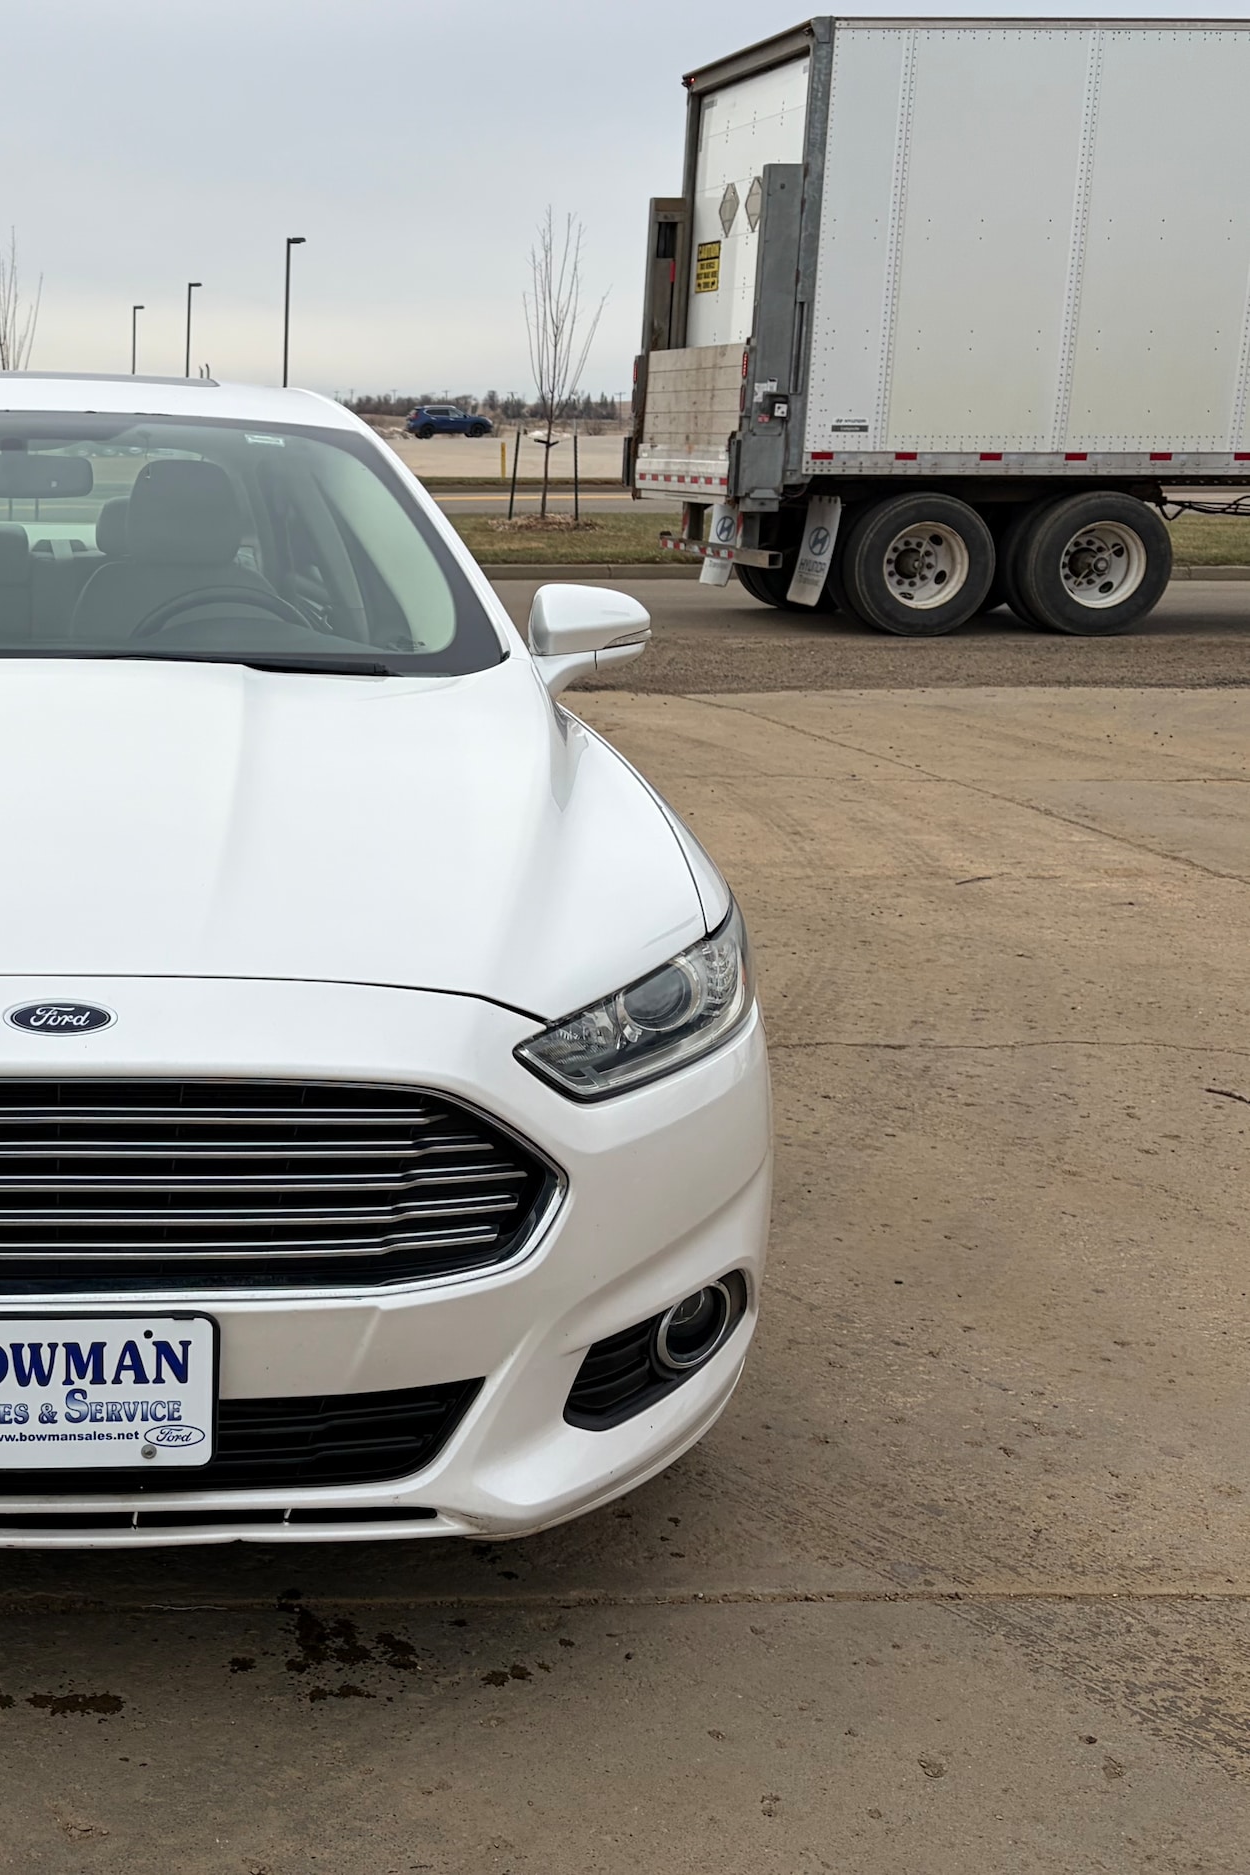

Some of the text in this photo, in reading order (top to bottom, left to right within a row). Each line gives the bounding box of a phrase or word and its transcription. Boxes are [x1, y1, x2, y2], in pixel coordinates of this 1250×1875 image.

[30, 1006, 91, 1027] Ford
[38, 1402, 58, 1424] &
[64, 1388, 182, 1424] SERVICE
[155, 1426, 193, 1444] Ford
